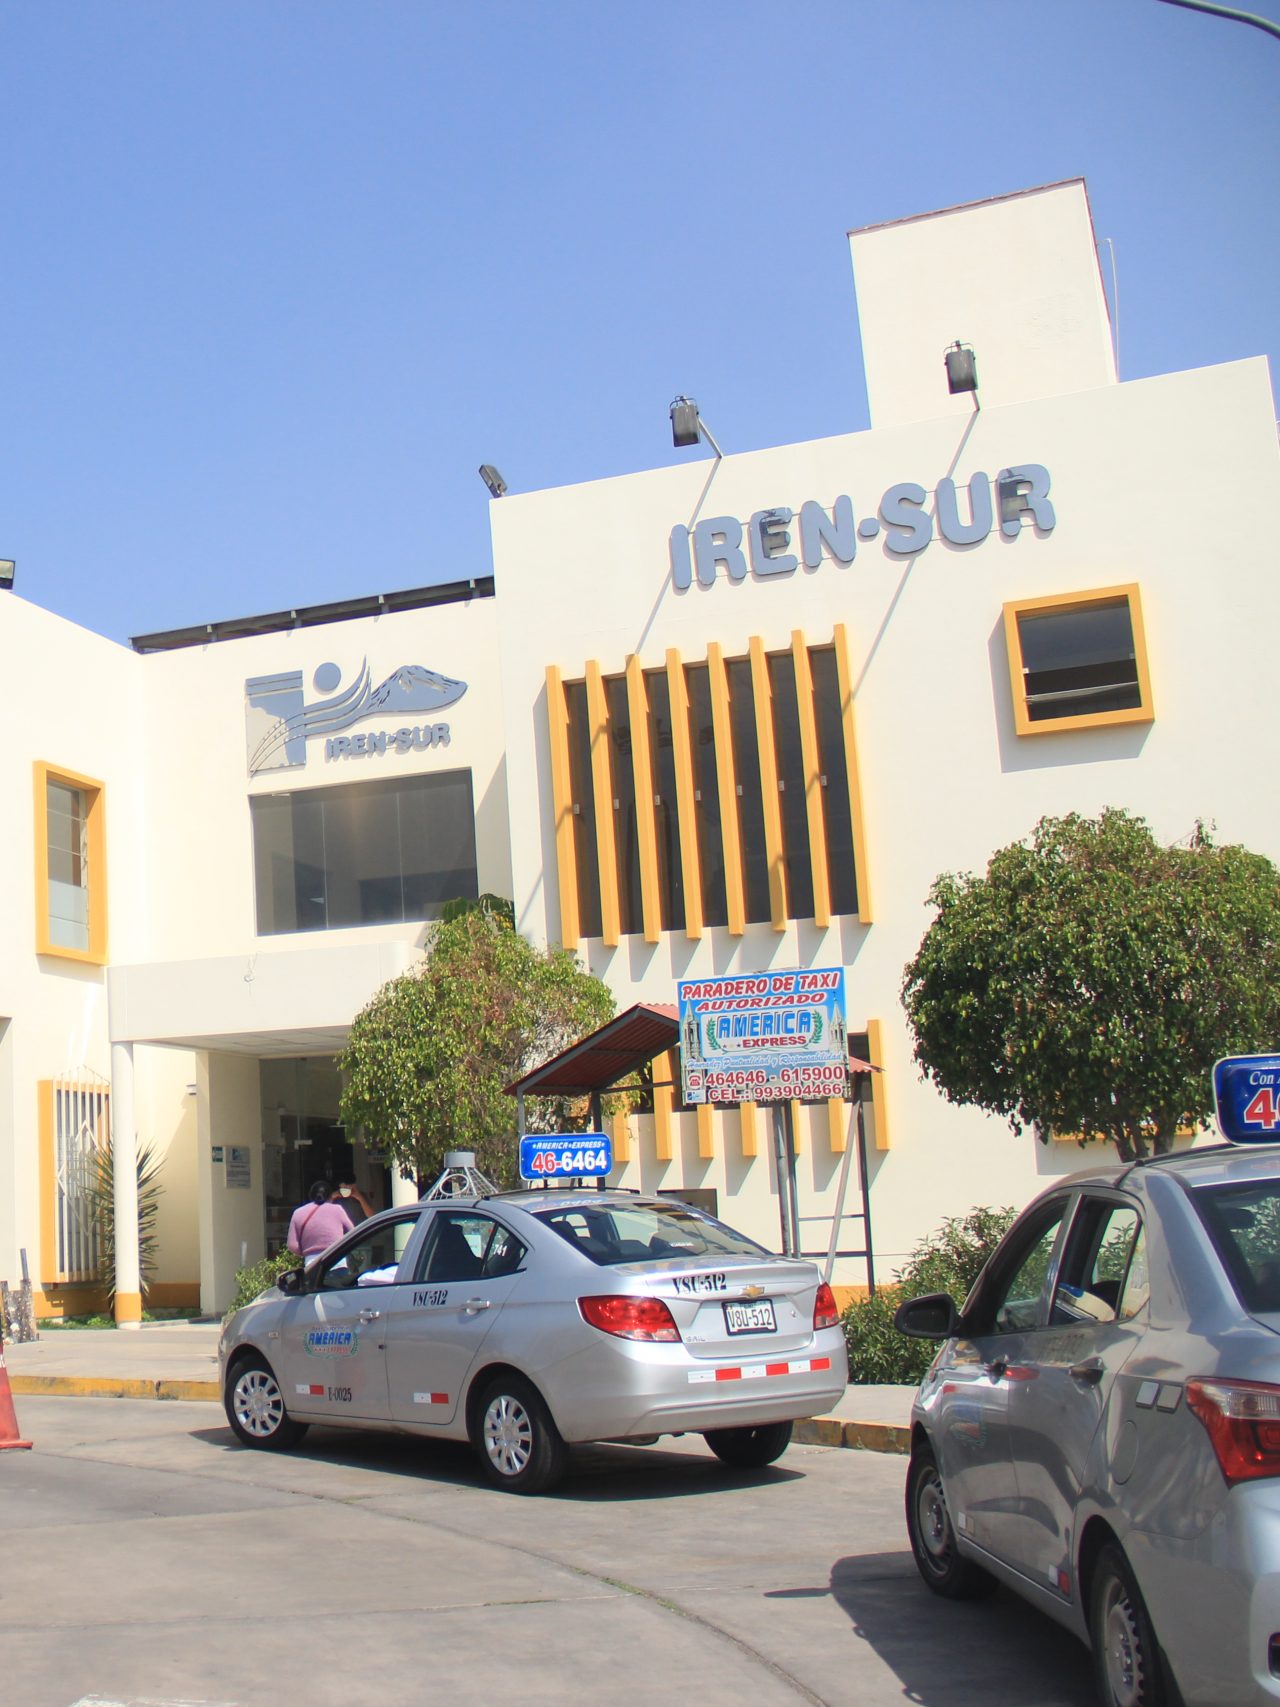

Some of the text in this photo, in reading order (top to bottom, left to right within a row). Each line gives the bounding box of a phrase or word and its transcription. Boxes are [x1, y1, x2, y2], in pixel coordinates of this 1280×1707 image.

[670, 464, 1056, 590] IREN-SUR
[327, 723, 451, 760] IREN-SUR
[682, 973, 839, 1000] PARADERO DE TAXI
[696, 993, 825, 1012] AUTORIZADO
[717, 1010, 812, 1039] AMERICA
[742, 1036, 807, 1049] EXPRESS
[705, 1070, 765, 1086] 464646
[781, 1066, 843, 1083] 615900
[1249, 1071, 1275, 1086] Con
[709, 1083, 842, 1101] CEL.: 993904466
[532, 1149, 607, 1174] 46-6464
[672, 1273, 727, 1295] V8U-512
[412, 1289, 449, 1306] V8U-512
[727, 1308, 773, 1329] V8U-512
[308, 1331, 352, 1346] AMERICA
